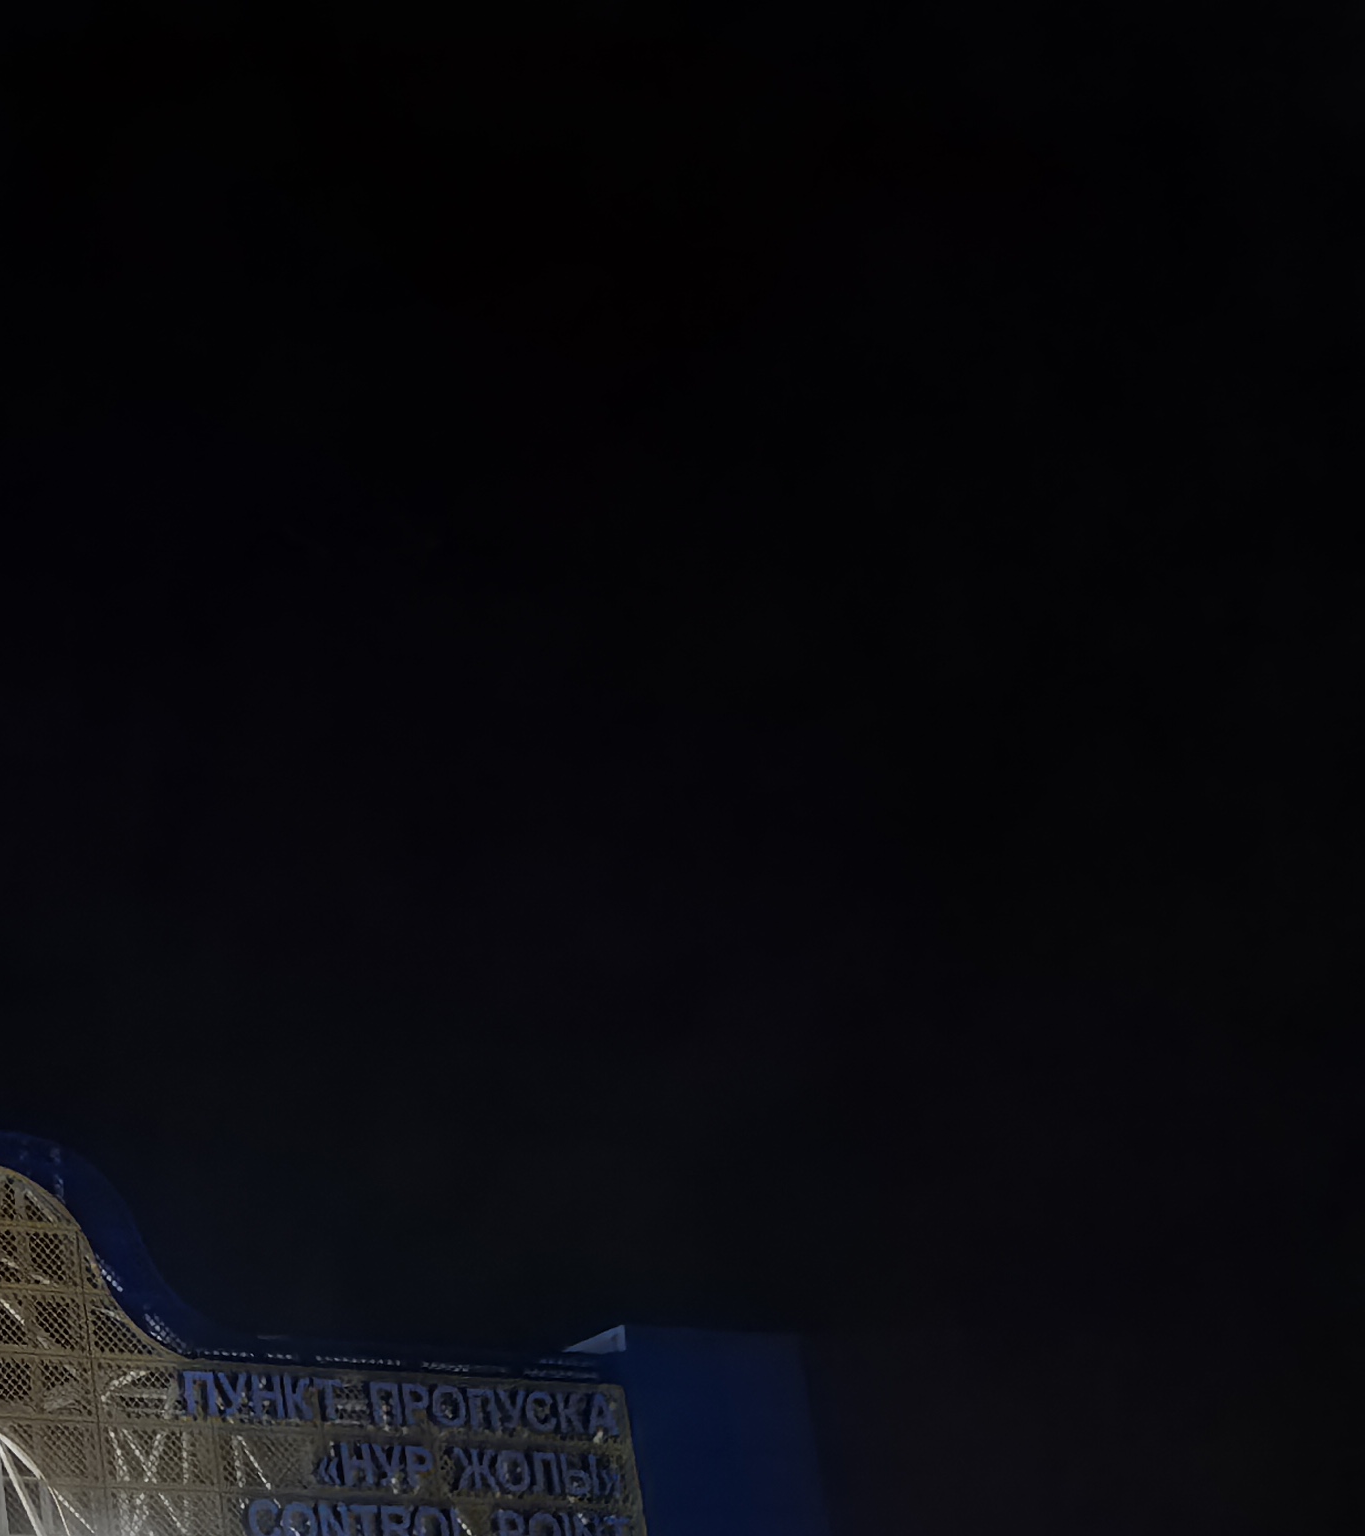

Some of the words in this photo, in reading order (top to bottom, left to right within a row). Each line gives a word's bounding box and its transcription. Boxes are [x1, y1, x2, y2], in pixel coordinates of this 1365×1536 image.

[182, 1371, 342, 1420] ПУНКТ
[370, 1382, 620, 1437] ПРОПУСКА
[315, 1442, 434, 1492] «НУР
